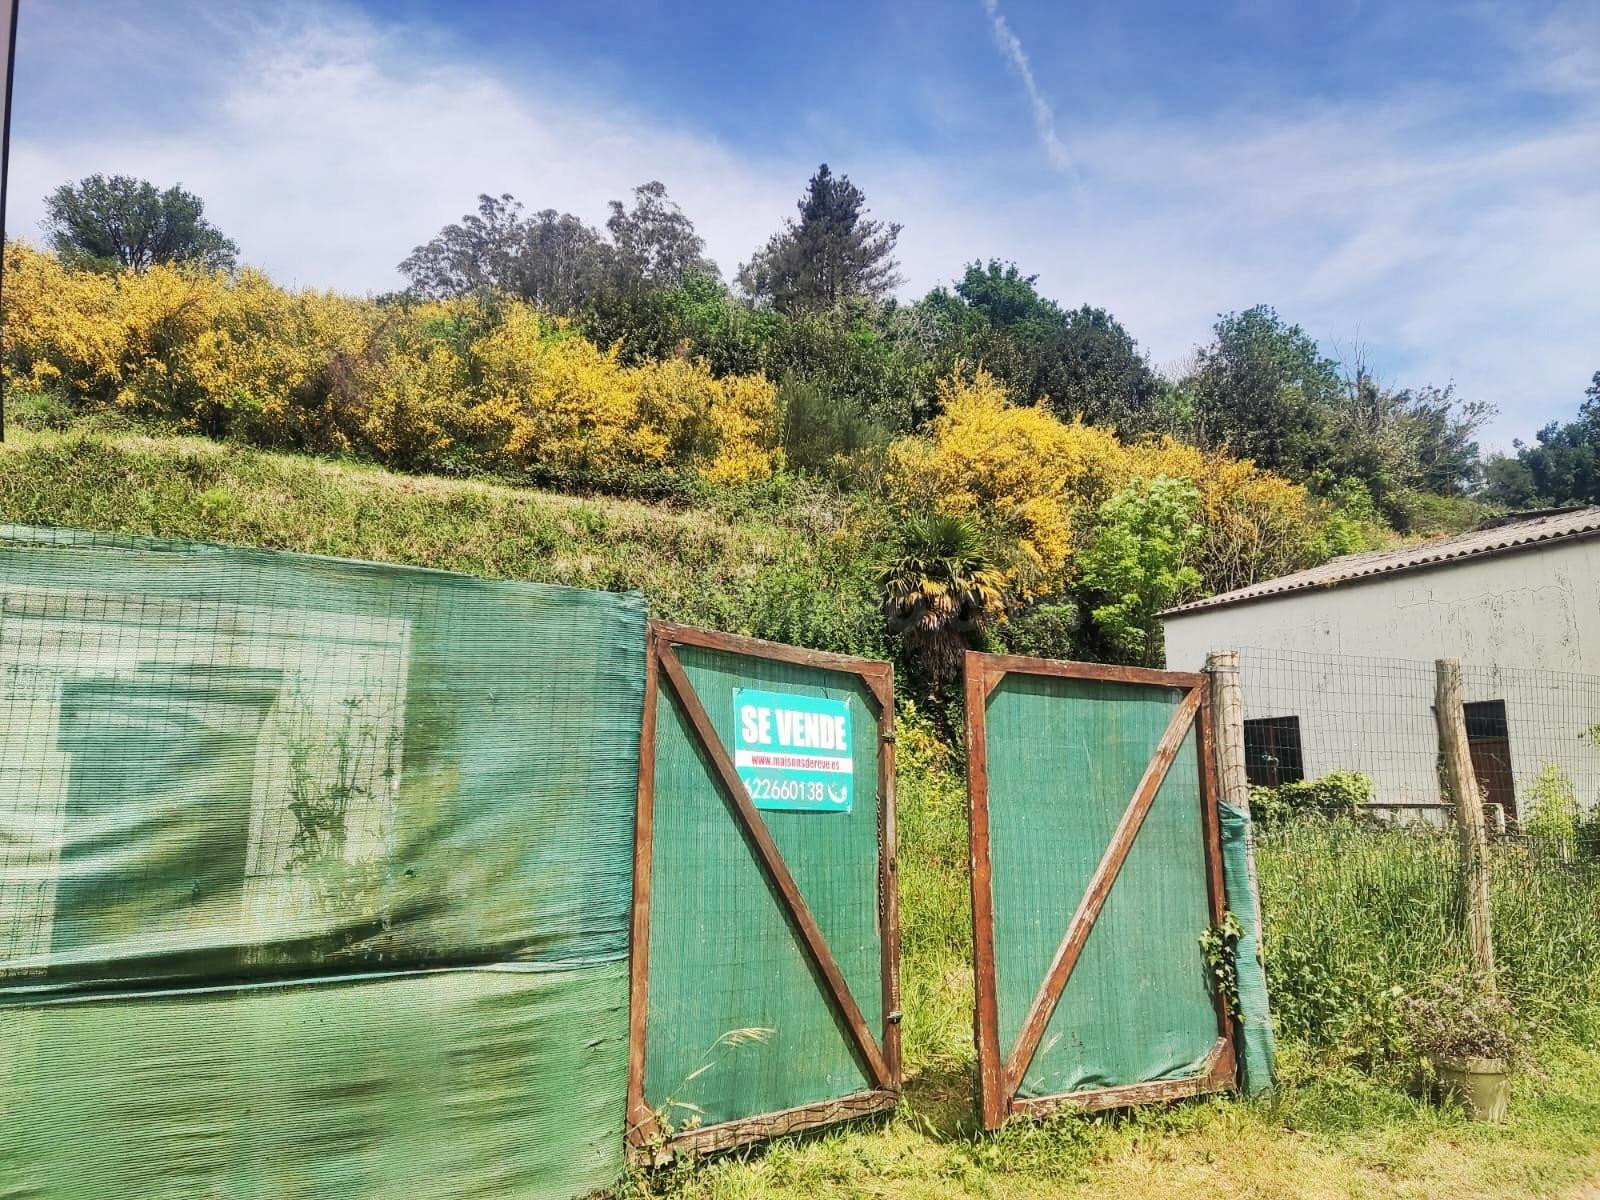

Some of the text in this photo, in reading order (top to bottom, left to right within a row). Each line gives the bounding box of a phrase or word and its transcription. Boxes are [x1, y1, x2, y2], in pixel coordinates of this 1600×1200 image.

[741, 705, 847, 751] SE VENDE
[751, 754, 840, 771] www.maisonsdereve.es
